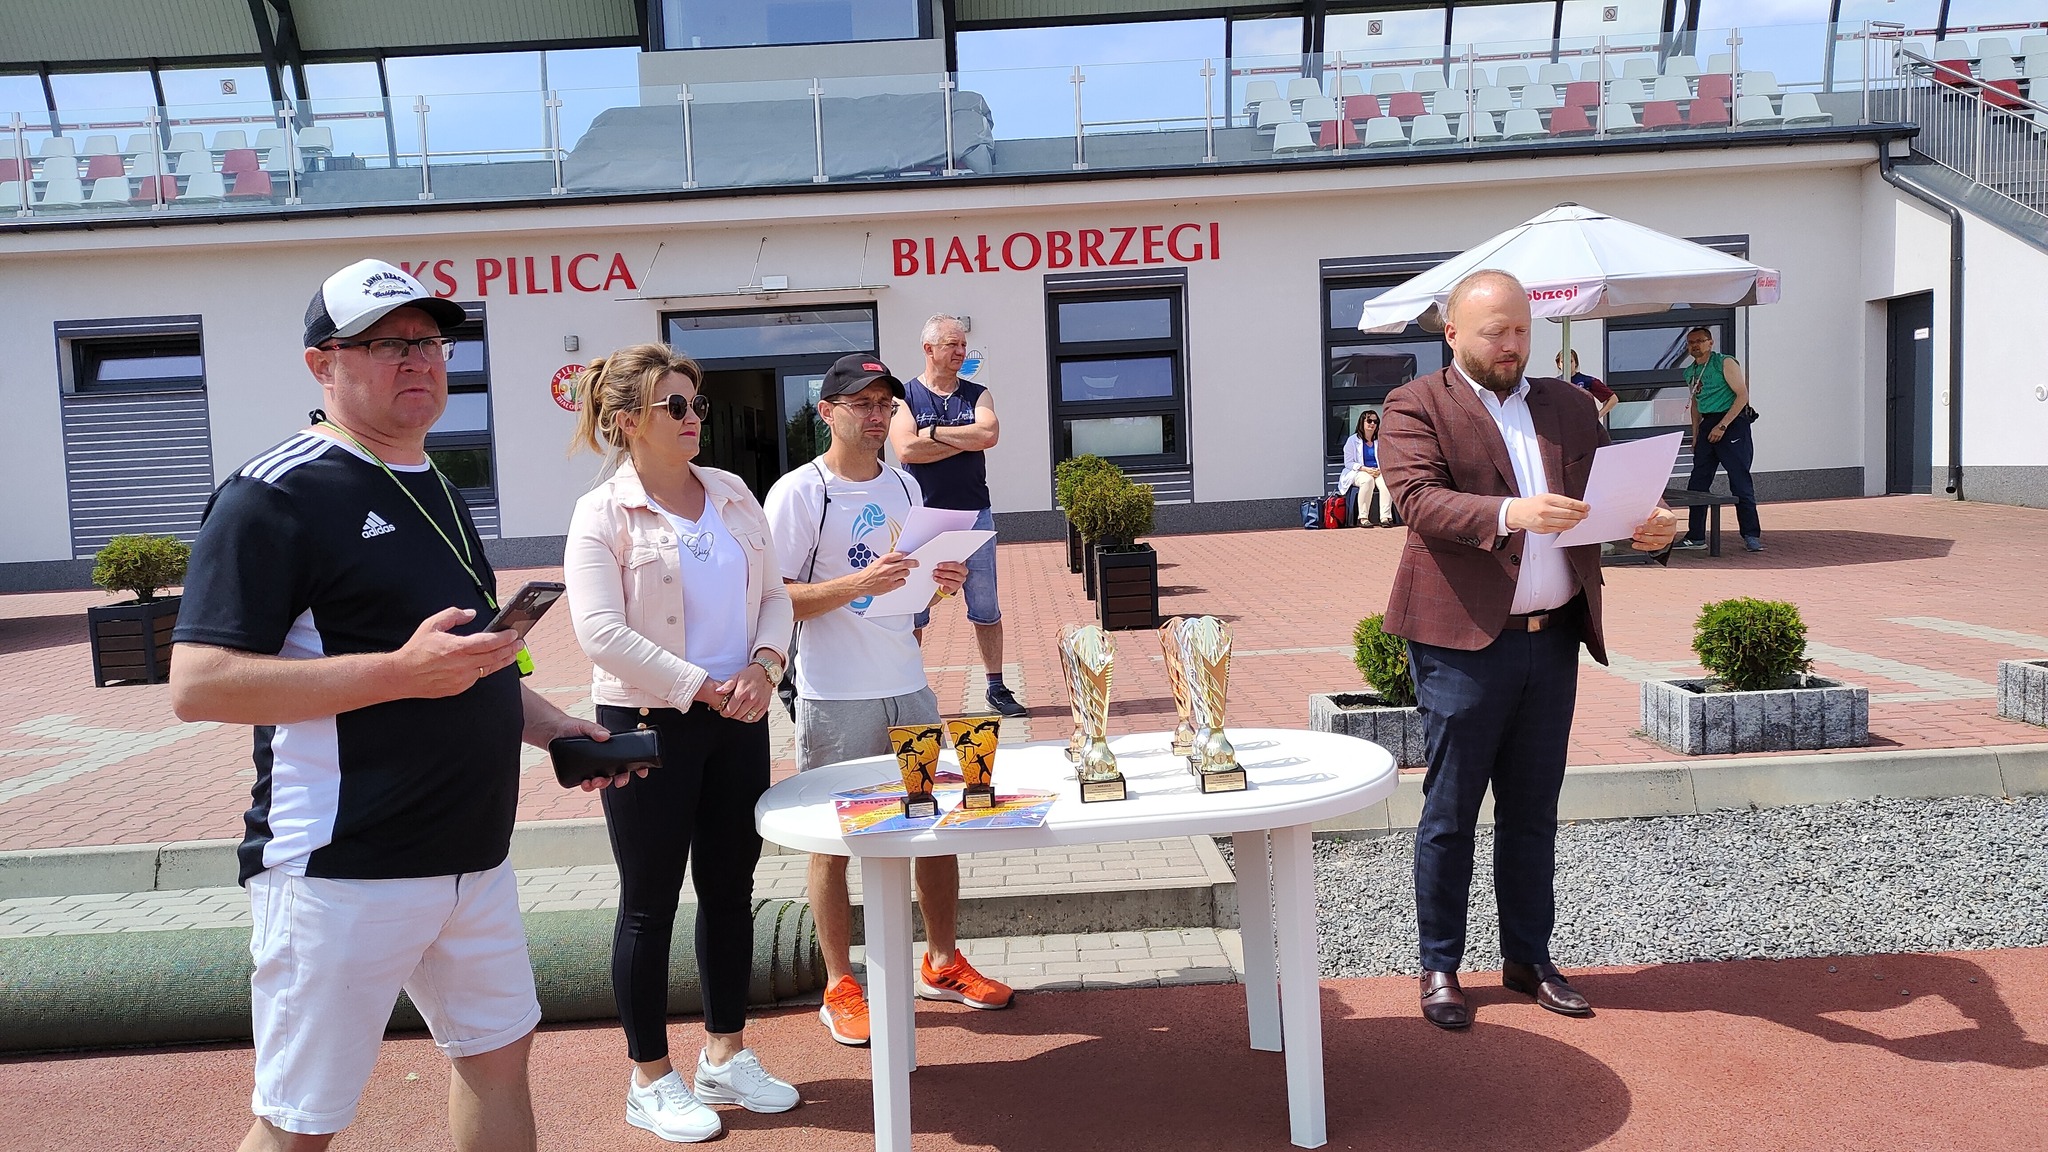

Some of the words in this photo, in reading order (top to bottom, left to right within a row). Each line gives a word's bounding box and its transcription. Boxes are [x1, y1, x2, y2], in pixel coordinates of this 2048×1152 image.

[476, 252, 637, 297] PILICA
[892, 222, 1220, 277] BIAŁOBRZEGI
[362, 273, 382, 287] LONG
[556, 366, 586, 379] PILIC
[361, 523, 396, 539] adidas
